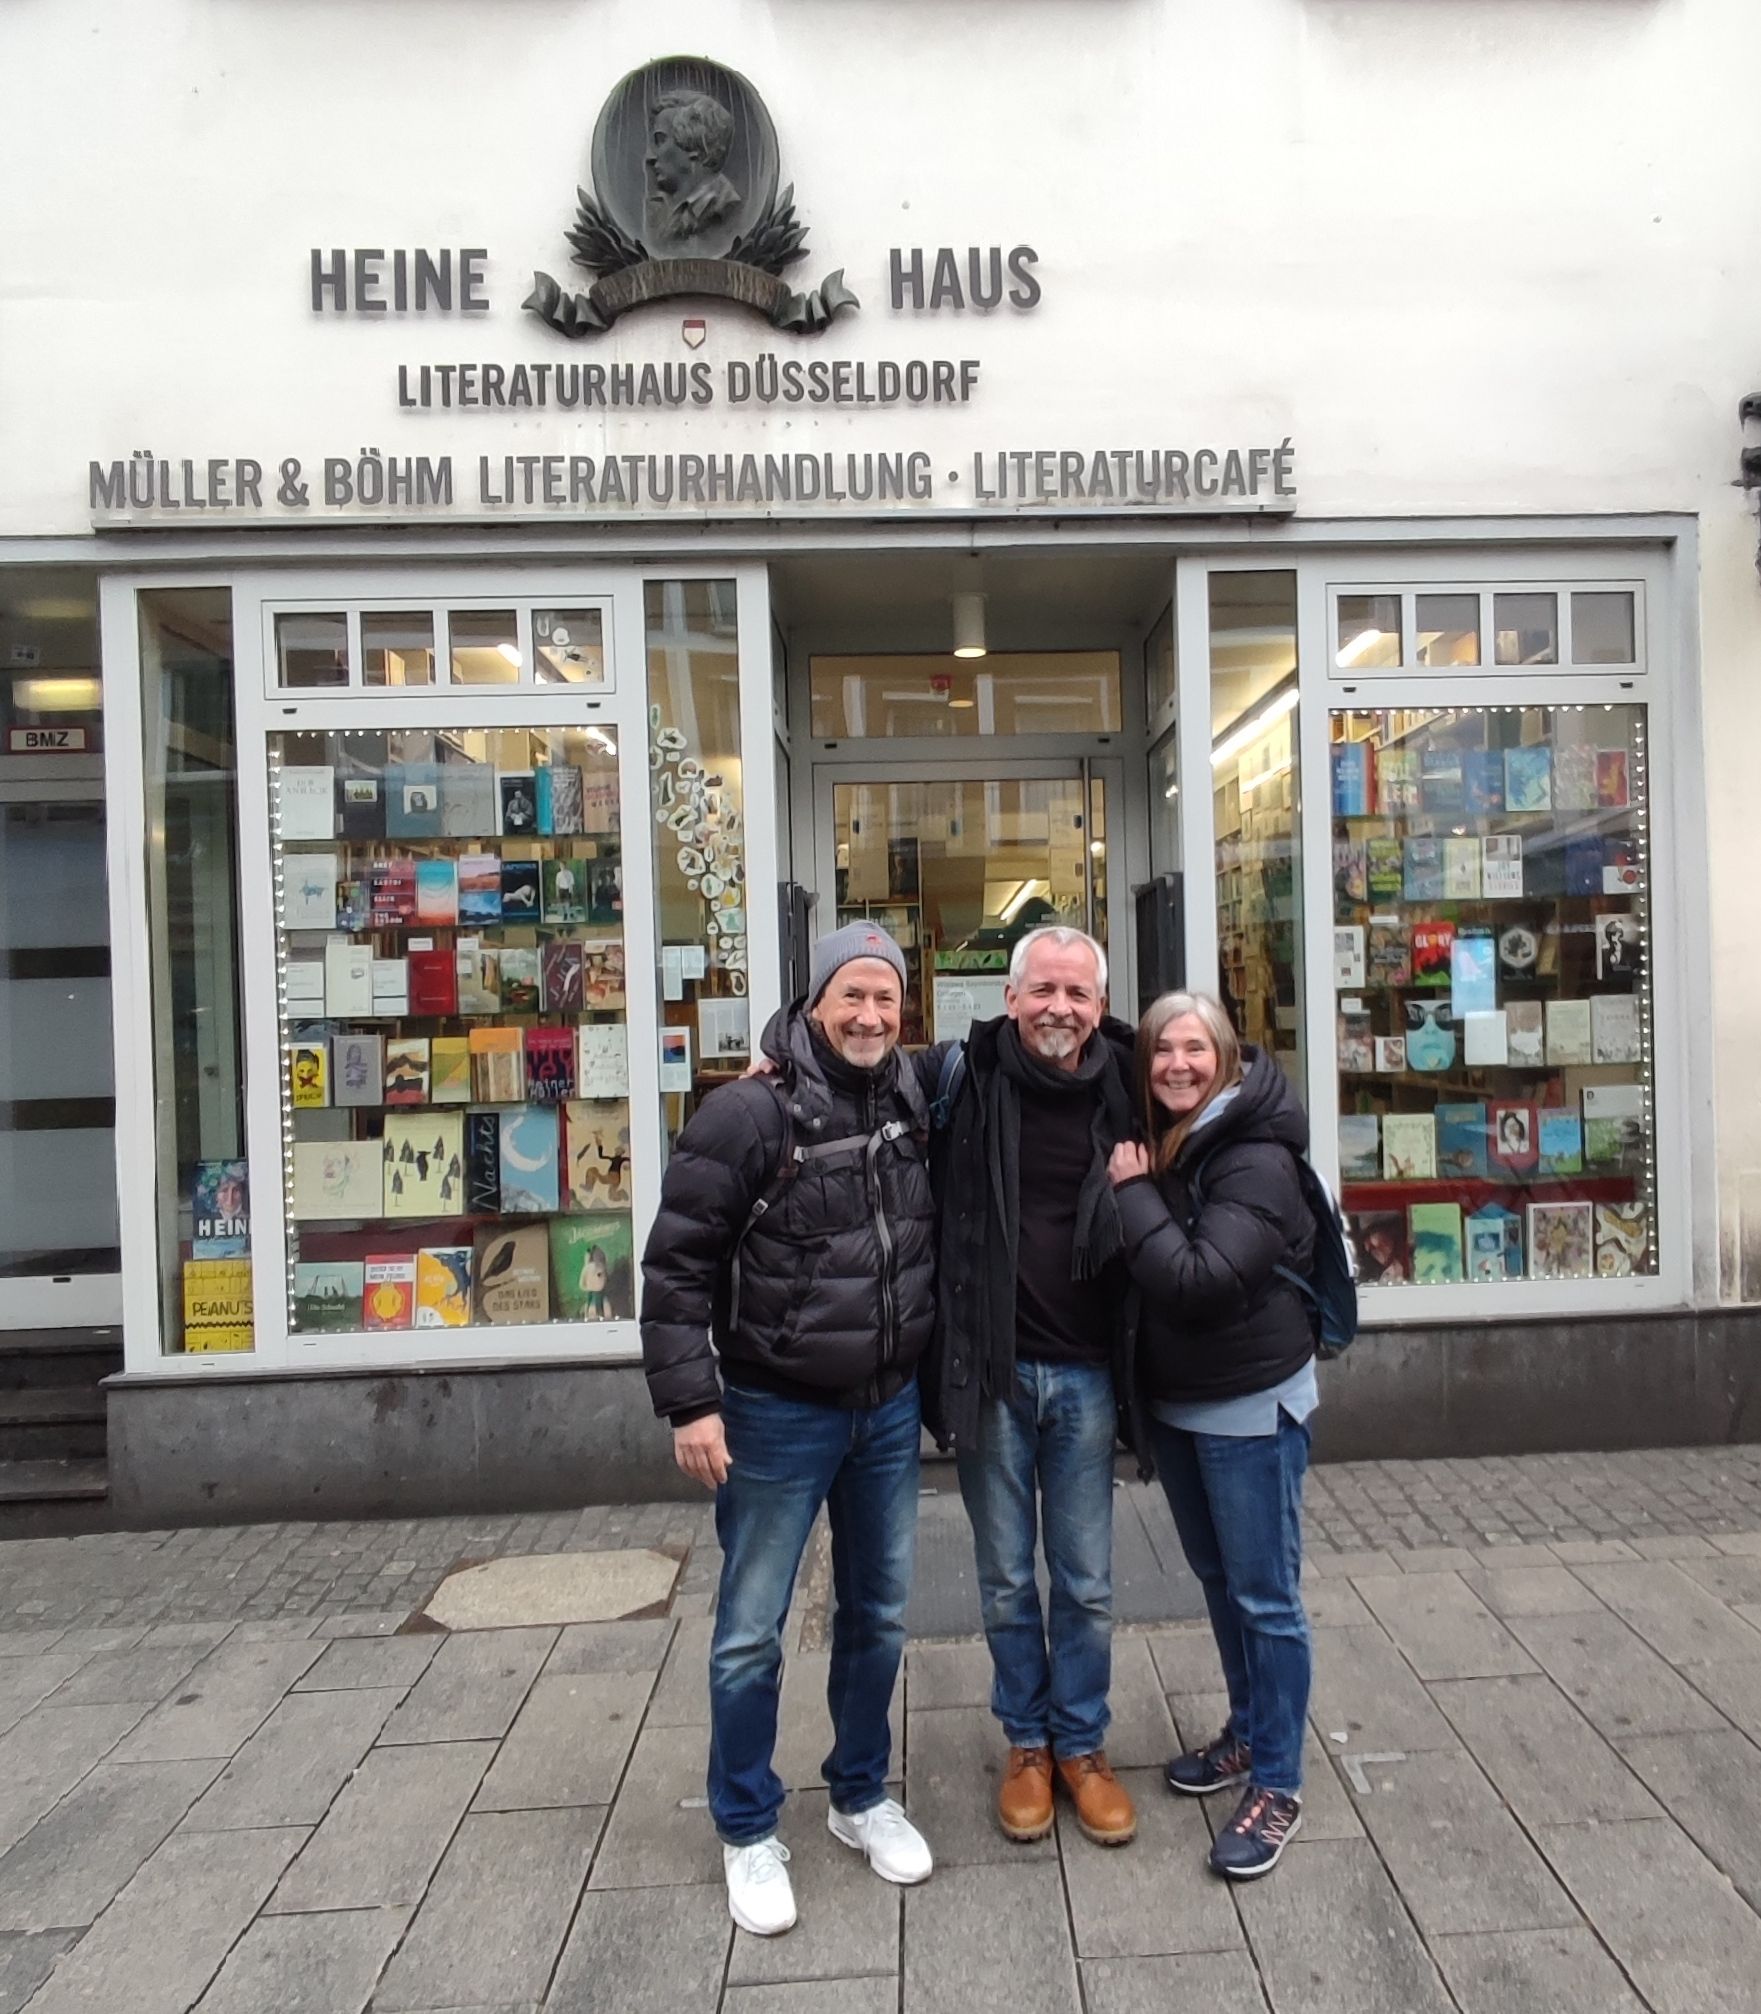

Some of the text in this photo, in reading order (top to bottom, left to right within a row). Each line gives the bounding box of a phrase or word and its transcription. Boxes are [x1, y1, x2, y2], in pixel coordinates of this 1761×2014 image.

[311, 246, 1041, 312] HEINE HAUS
[398, 354, 981, 408] LITERATURHAUS DÜSSELDORF
[89, 450, 263, 509] MÜLLER
[277, 457, 311, 507] &
[324, 447, 453, 508] BÖHM
[479, 451, 932, 506] LITERATURHANDLUNG
[974, 437, 1297, 500] LITERATURCAFÉ
[26, 732, 69, 747] BMZ
[199, 1218, 251, 1236] HEIN
